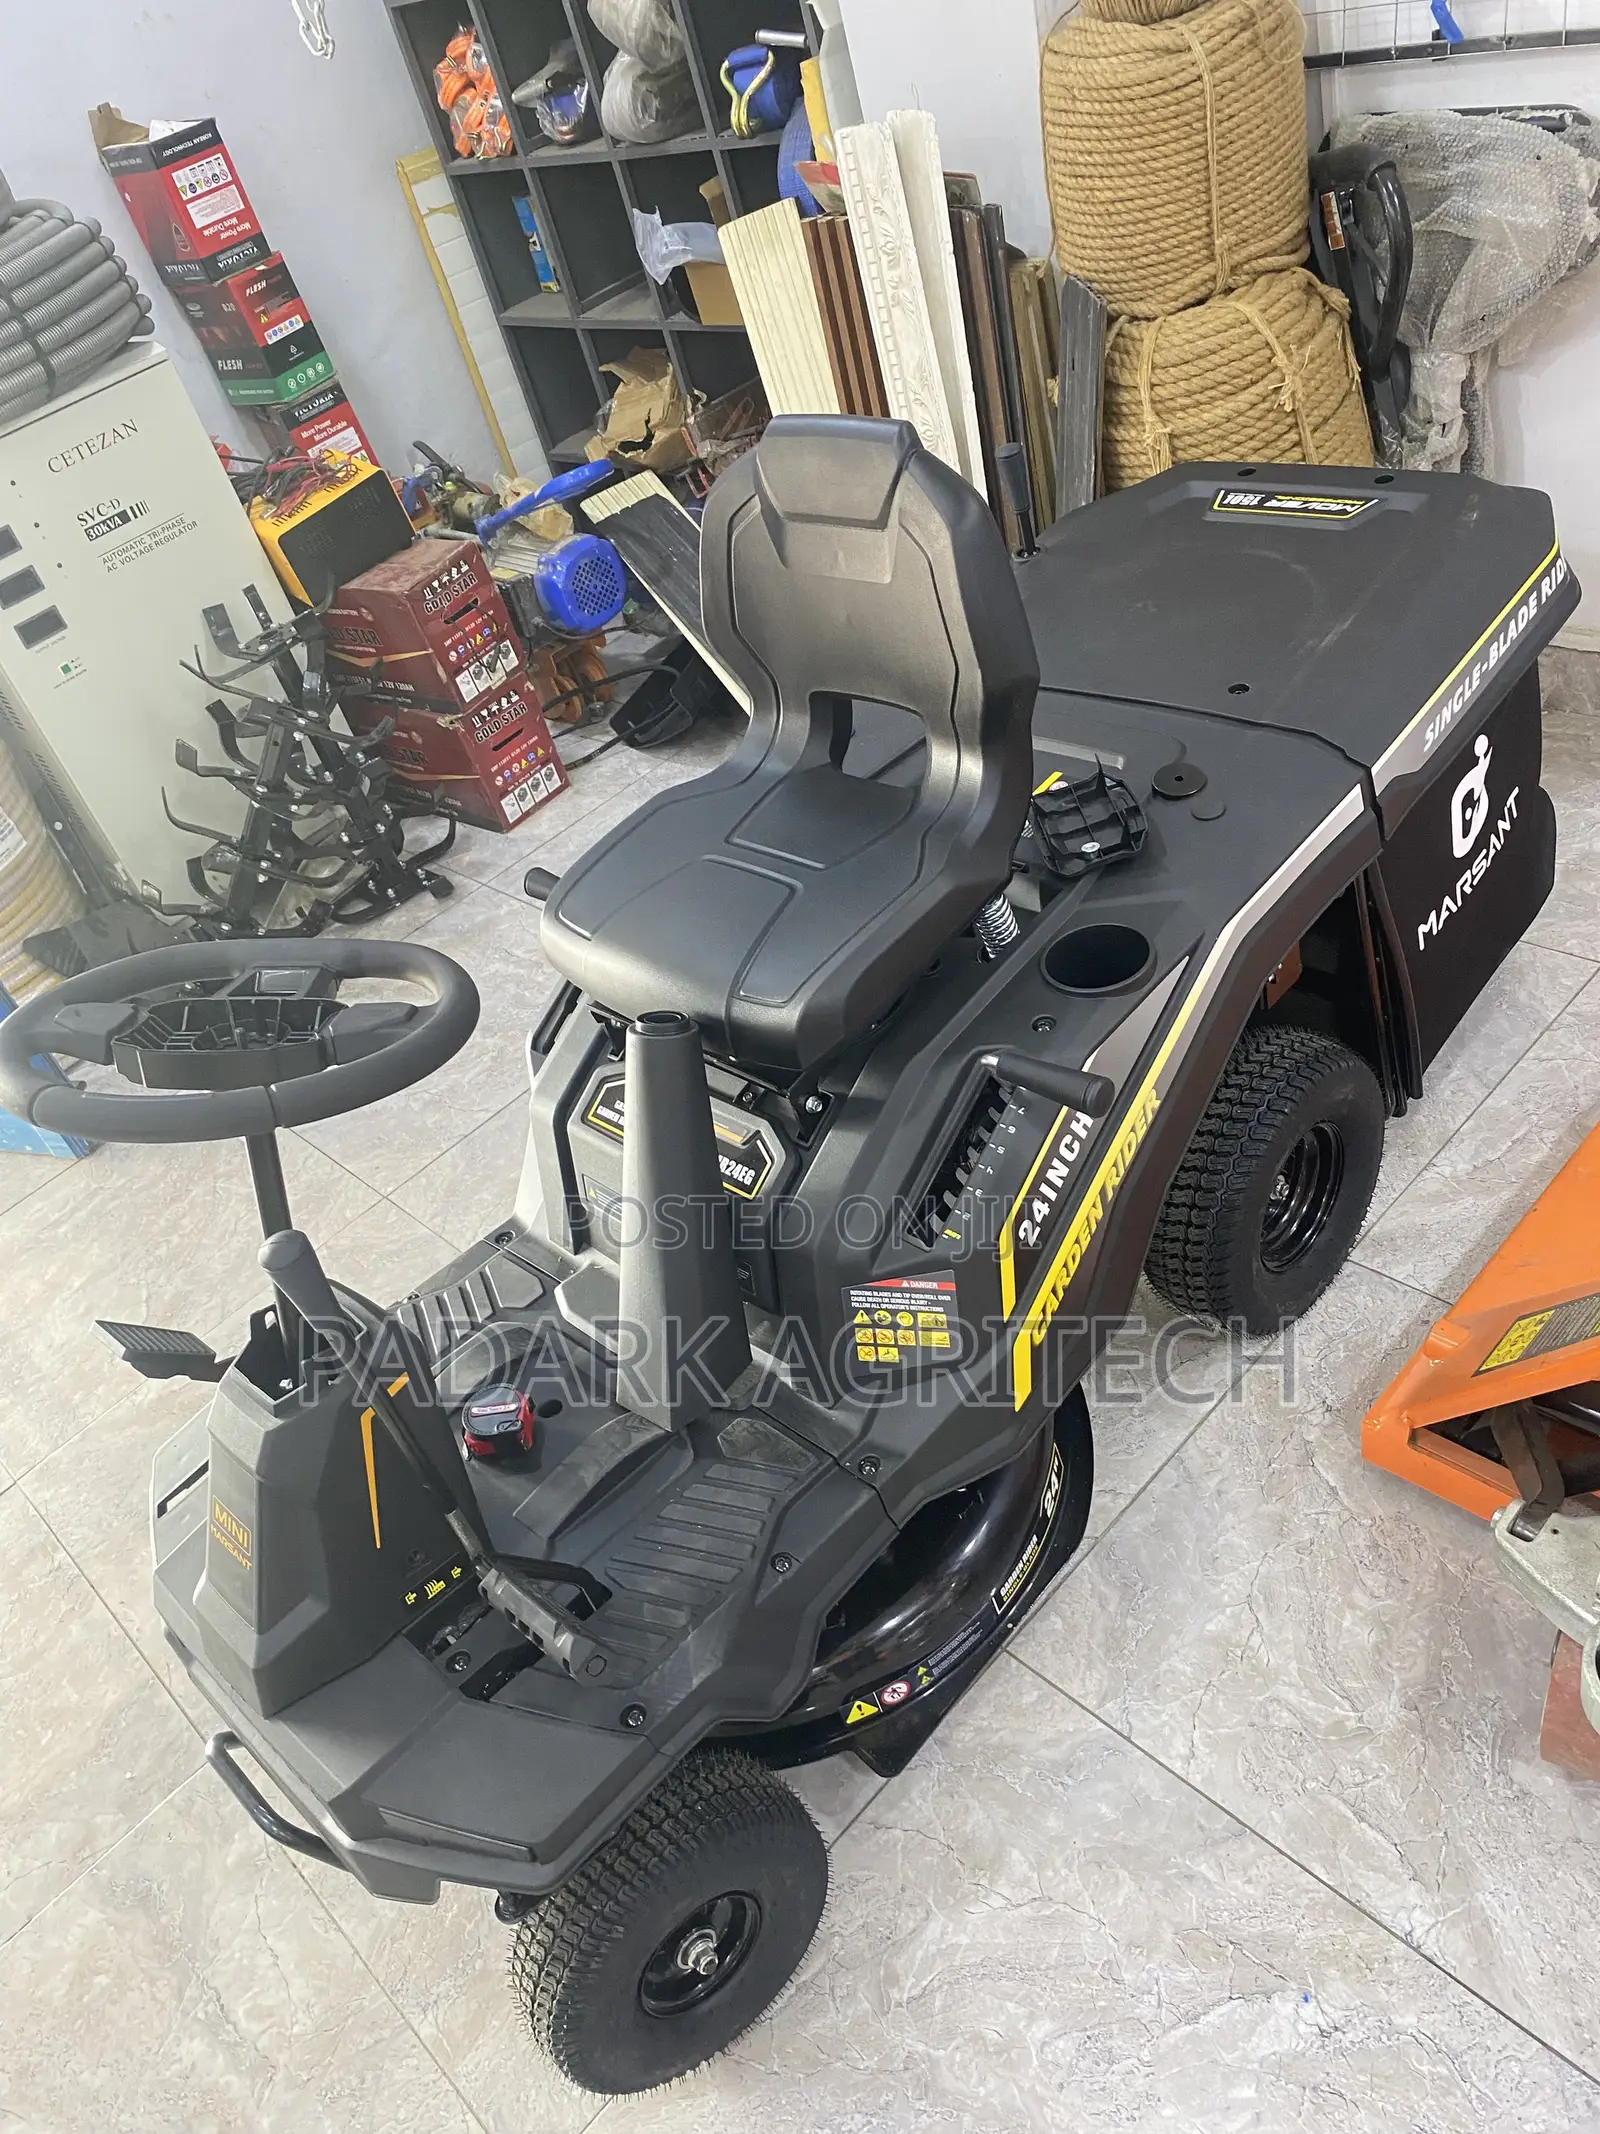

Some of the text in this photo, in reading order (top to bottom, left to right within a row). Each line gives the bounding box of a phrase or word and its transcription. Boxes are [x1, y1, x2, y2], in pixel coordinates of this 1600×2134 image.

[162, 140, 193, 157] TECHNOLOGY
[202, 216, 238, 237] More Durable
[220, 223, 252, 240] More Power
[246, 280, 267, 297] FLESH
[218, 360, 243, 372] FLESH
[300, 419, 332, 439] More Power
[313, 419, 348, 442] More Durable
[48, 418, 140, 473] CETEZAN
[76, 498, 121, 528] SVC-D
[1264, 500, 1360, 512] MOVER
[102, 516, 186, 566] AUTOMATIC TRI-PHASE
[106, 520, 198, 573] AC VOLTAGE REGULATOR
[452, 572, 478, 598] STAR
[1424, 590, 1537, 752] SINGLE-BLADE
[474, 701, 528, 743] GOLD STAR
[1416, 786, 1520, 951] MARSANT
[1018, 1106, 1026, 1115] 7
[1006, 1125, 1016, 1134] 6
[996, 1146, 1006, 1154] 5
[1104, 1088, 1162, 1202] RIDER
[718, 1154, 756, 1186] R24EG
[986, 1166, 994, 1175] 4
[974, 1188, 984, 1197] 3
[962, 1212, 971, 1220] 2
[910, 1280, 938, 1288] DANGER
[215, 1503, 248, 1548] MINI
[210, 1524, 252, 1570] MARSANT
[1000, 1534, 1038, 1596] GARDEN RIDER
